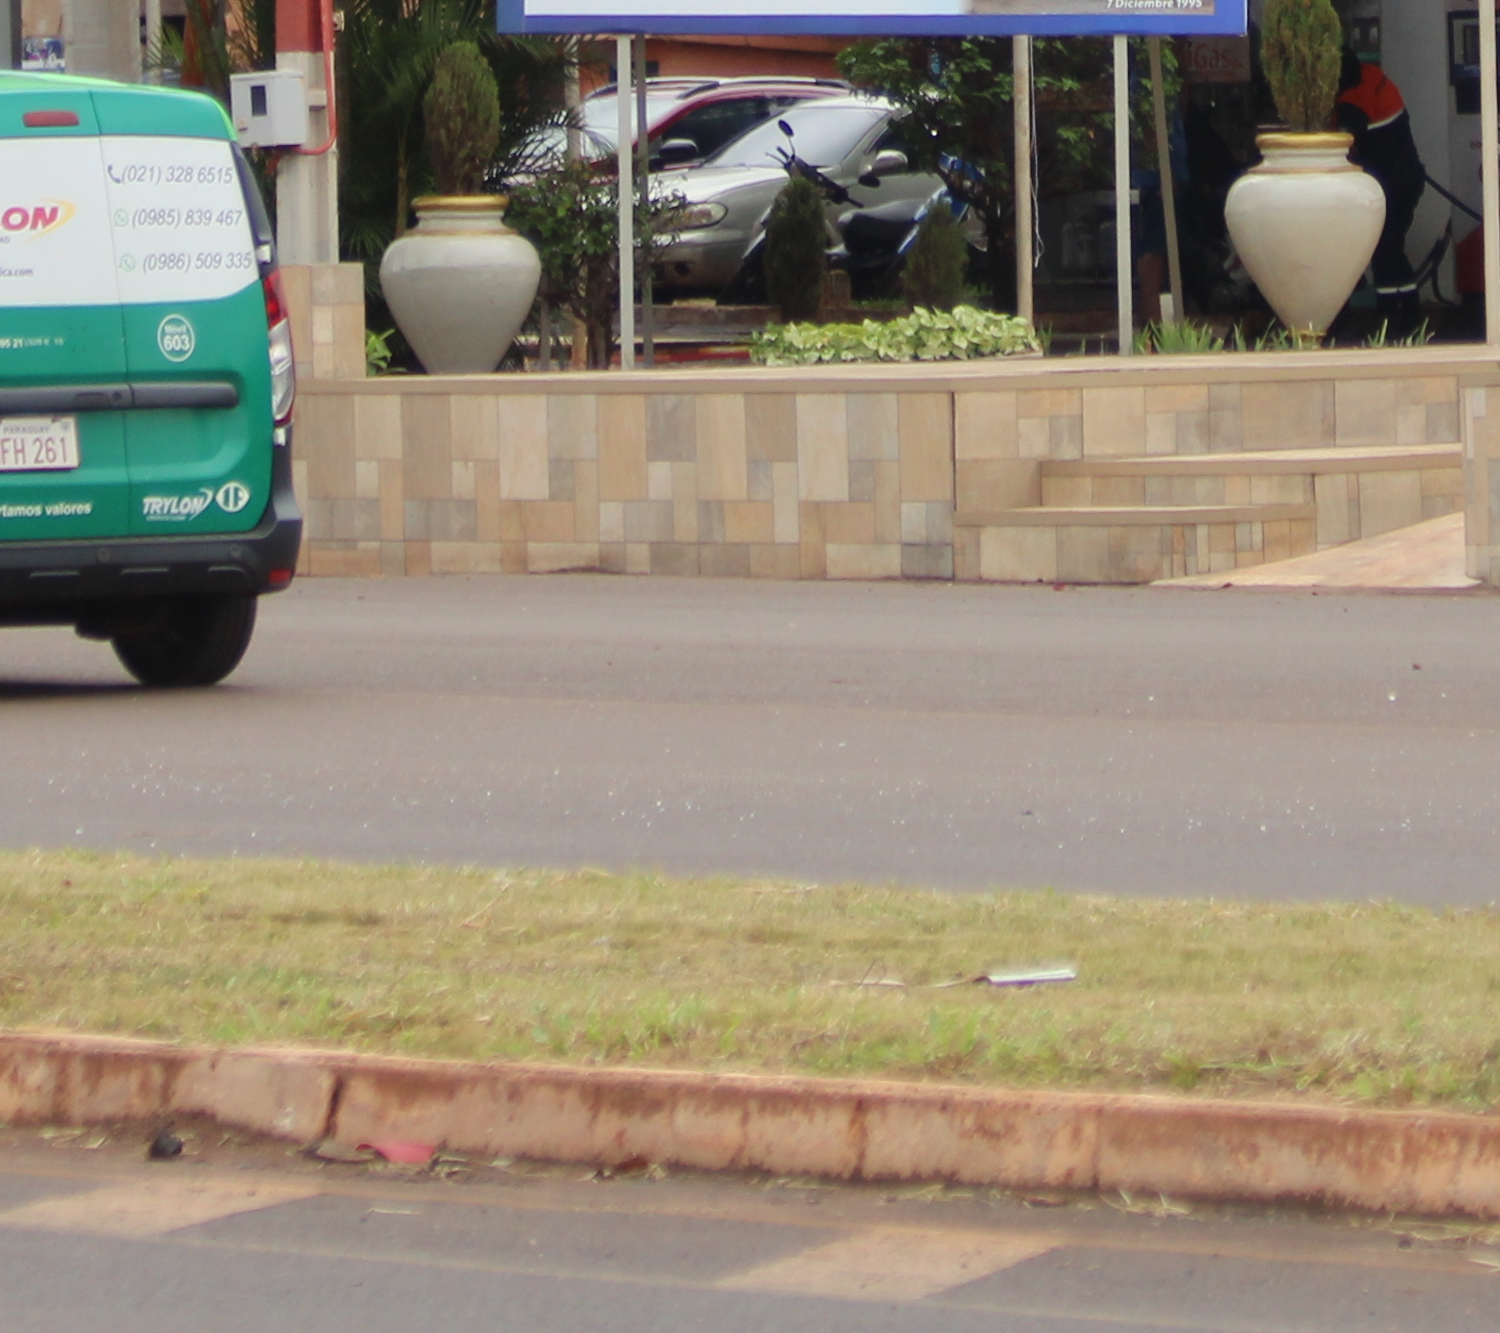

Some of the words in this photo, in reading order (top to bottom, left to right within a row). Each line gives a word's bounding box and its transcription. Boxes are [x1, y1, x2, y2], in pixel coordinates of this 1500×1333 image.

[121, 165, 161, 186] (021)
[166, 165, 193, 183] 328
[197, 166, 233, 184] 6515
[132, 209, 180, 229] (0985)
[185, 209, 212, 226] 839
[216, 209, 243, 226] 467
[143, 253, 191, 274] (0986)
[194, 252, 222, 269] 509
[225, 251, 253, 269] 335
[12, 337, 23, 349] 21
[164, 334, 190, 351] 603
[33, 437, 67, 464] 261
[45, 501, 92, 517] valores
[143, 496, 205, 514] TRYLON
